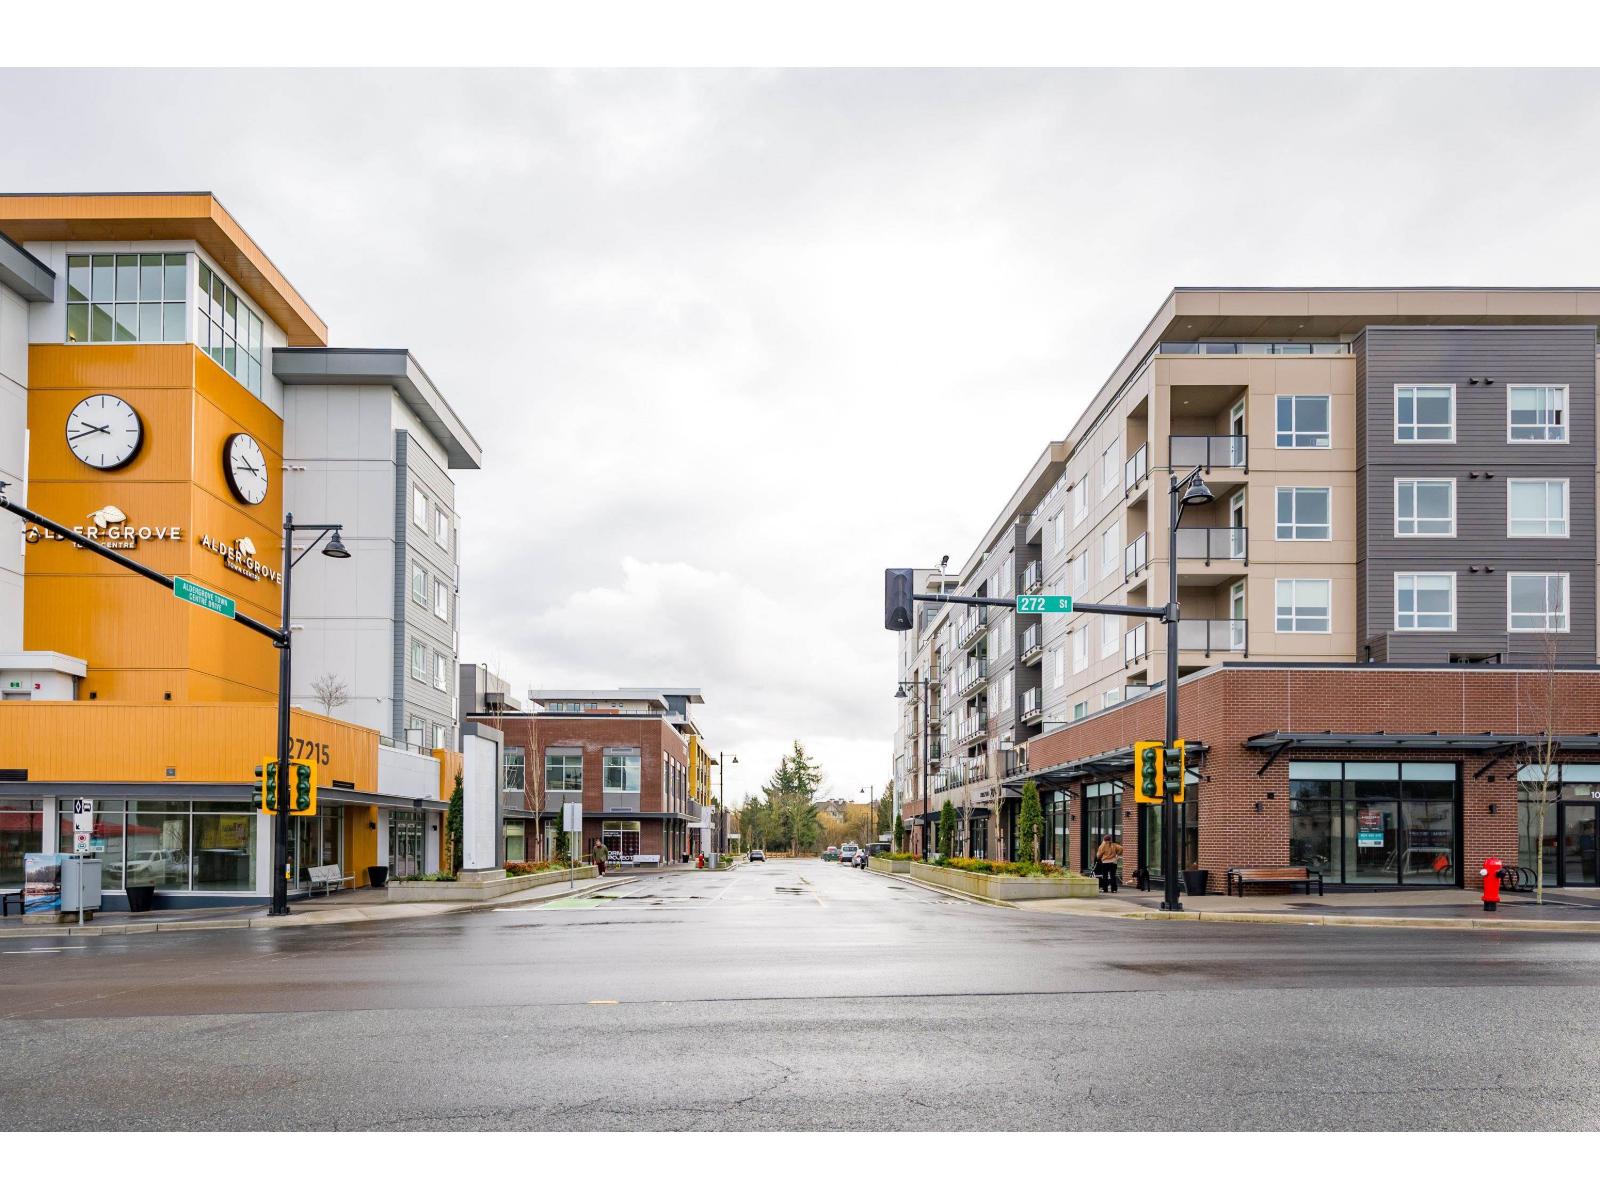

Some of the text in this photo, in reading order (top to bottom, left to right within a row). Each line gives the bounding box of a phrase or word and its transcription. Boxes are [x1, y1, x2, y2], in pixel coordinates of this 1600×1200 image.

[29, 526, 181, 540] ALER GROVE
[246, 557, 282, 585] GROVE
[1021, 598, 1045, 610] 272
